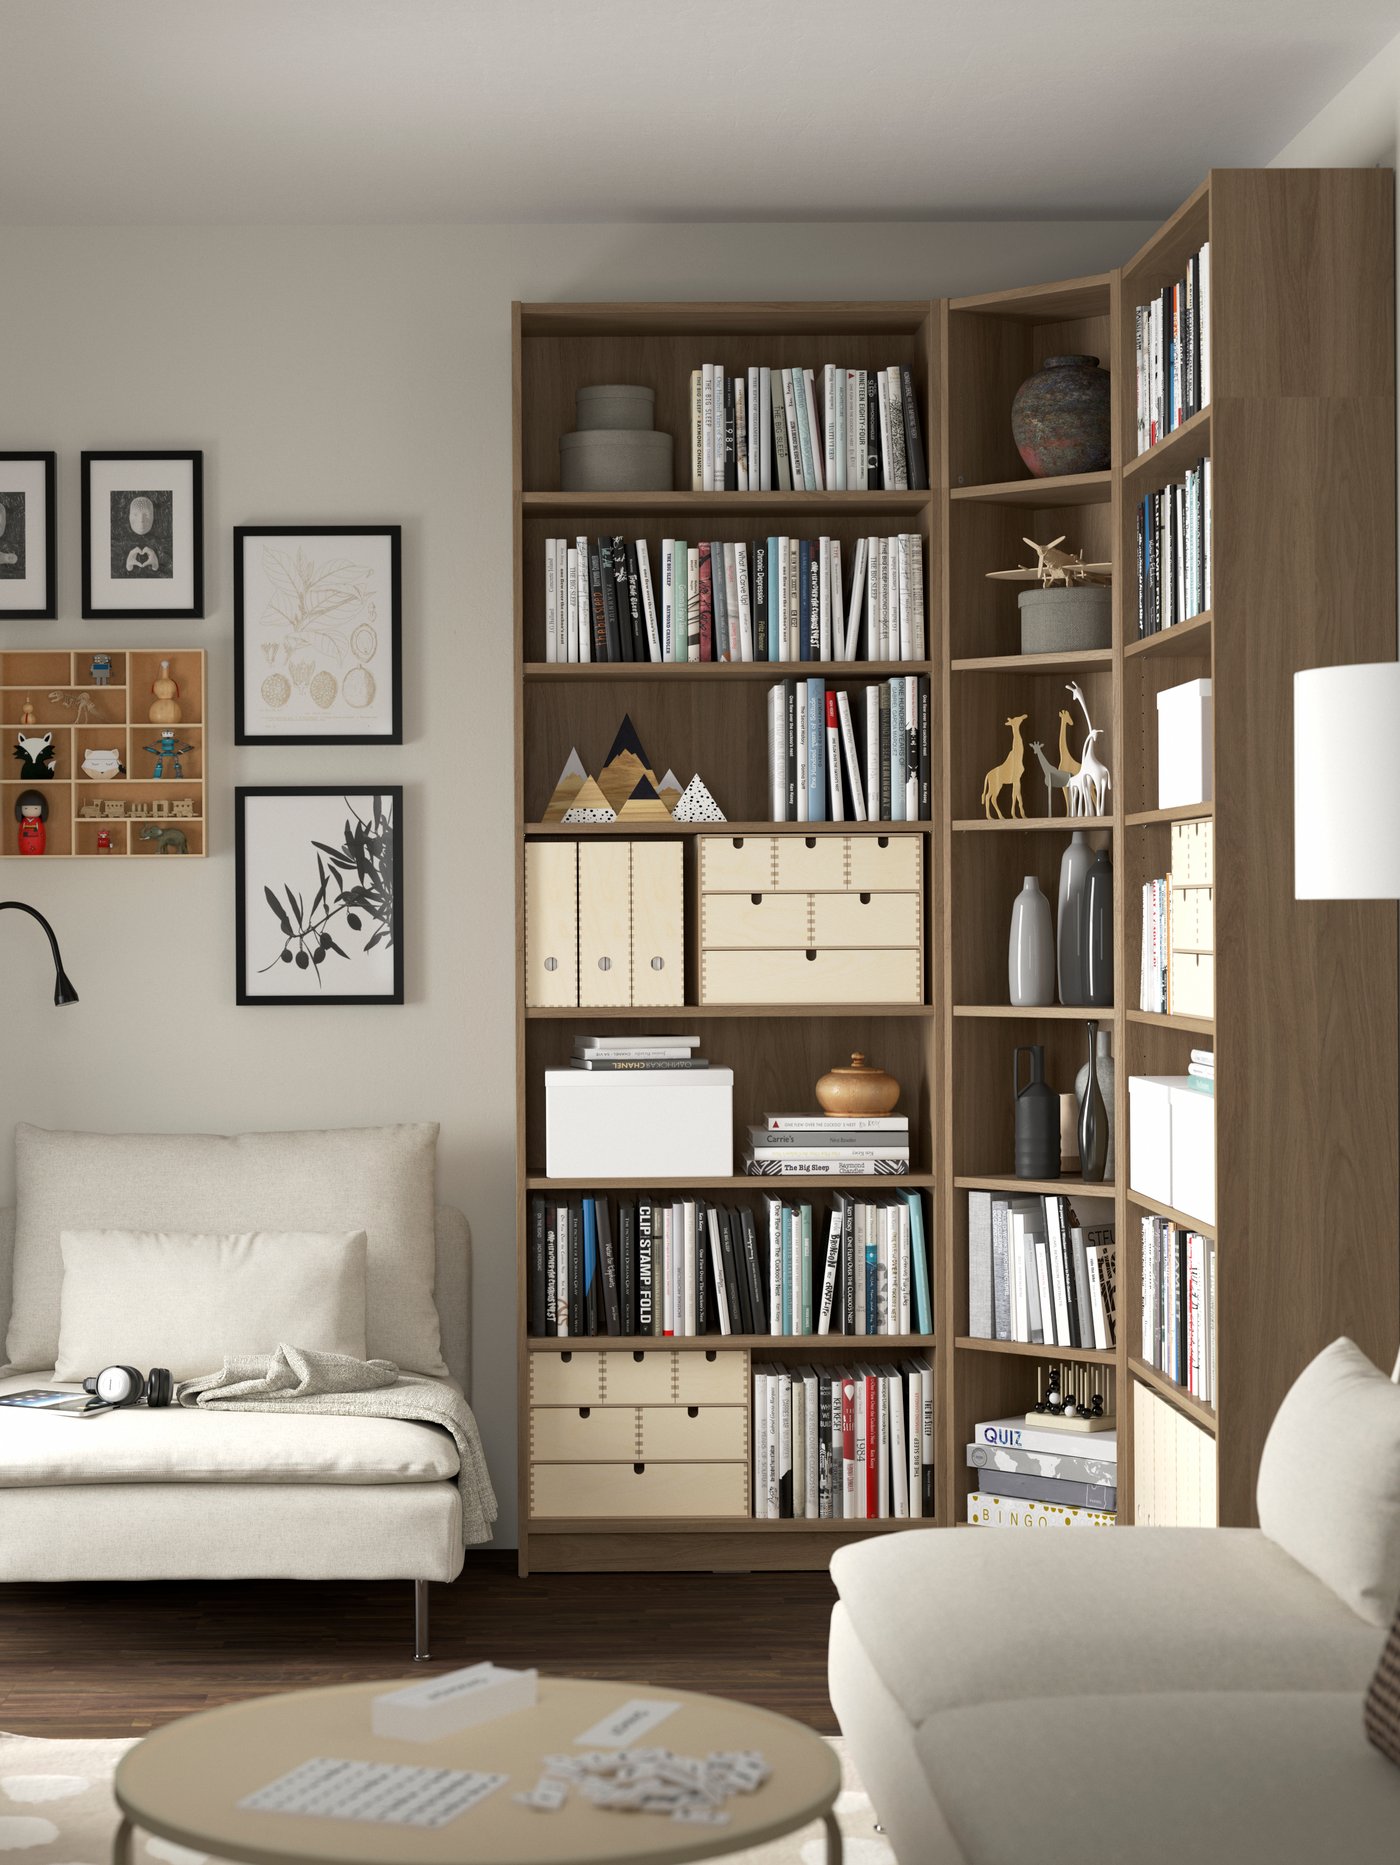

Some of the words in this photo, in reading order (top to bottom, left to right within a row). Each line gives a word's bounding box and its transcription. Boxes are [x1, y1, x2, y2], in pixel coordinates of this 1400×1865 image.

[725, 421, 733, 451] 1984
[776, 437, 784, 458] SLEEP
[738, 550, 746, 567] What
[756, 572, 764, 604] Depression
[767, 1135, 794, 1143] Carrie's
[799, 1164, 810, 1172] Big
[812, 1163, 830, 1172] Sleep
[640, 1207, 651, 1235] CLIP
[640, 1239, 651, 1285] STAMP
[640, 1291, 651, 1323] FOLD
[924, 1400, 932, 1409] THE
[924, 1411, 932, 1419] BIG
[924, 1421, 932, 1436] SLEEP
[984, 1427, 1022, 1446] QUIZ
[857, 1438, 865, 1462] 1984
[982, 1508, 1047, 1527] BINGO
